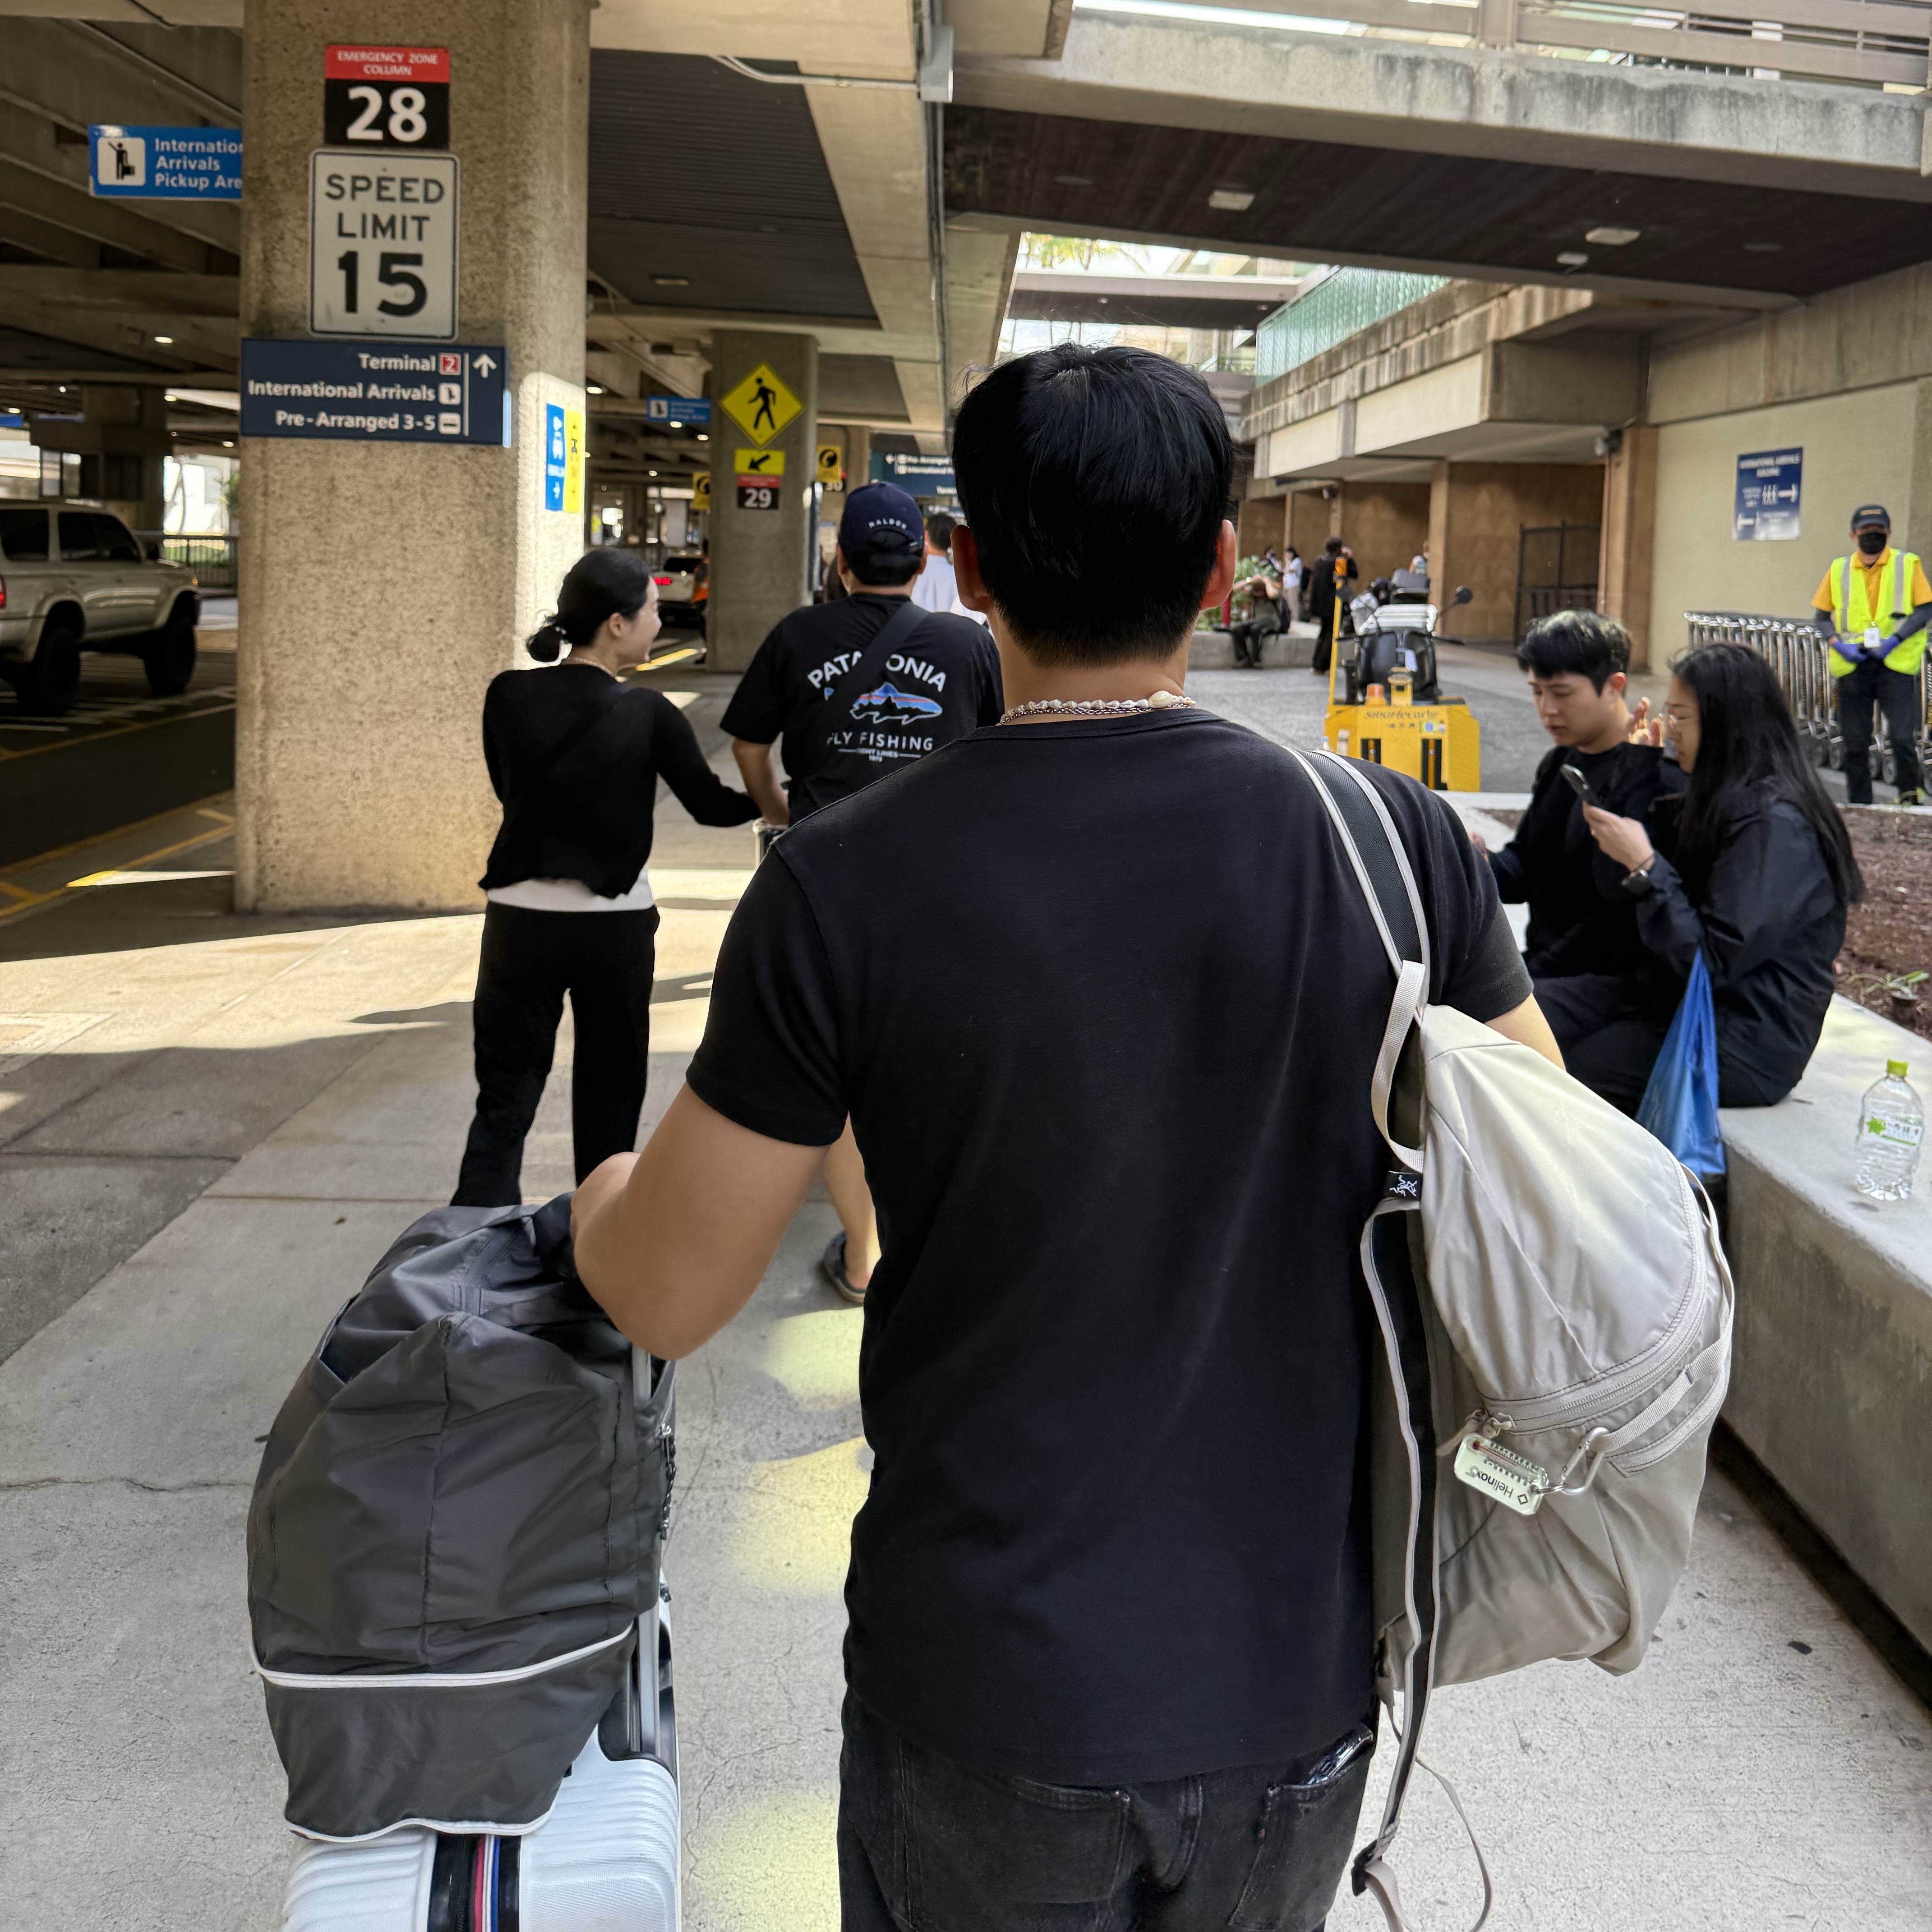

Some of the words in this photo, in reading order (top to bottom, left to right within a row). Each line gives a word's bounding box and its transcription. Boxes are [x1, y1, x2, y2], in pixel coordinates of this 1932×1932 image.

[337, 51, 404, 63] EMERGENCY
[408, 53, 438, 64] ZONE
[363, 64, 412, 76] COLUMN
[346, 86, 427, 143] 28
[156, 155, 220, 171] Arrivals
[155, 172, 209, 192] Pickup
[325, 174, 444, 204] SPEED
[337, 212, 430, 241] LIMIT
[338, 250, 427, 317] 15
[358, 353, 436, 372] Terminal
[445, 357, 455, 372] 2
[248, 380, 362, 399] International
[366, 382, 436, 401] Arrivals
[402, 414, 436, 431] 3-5
[744, 488, 772, 508] 29
[807, 651, 946, 693] PATAONIA
[859, 731, 933, 751] FISHING
